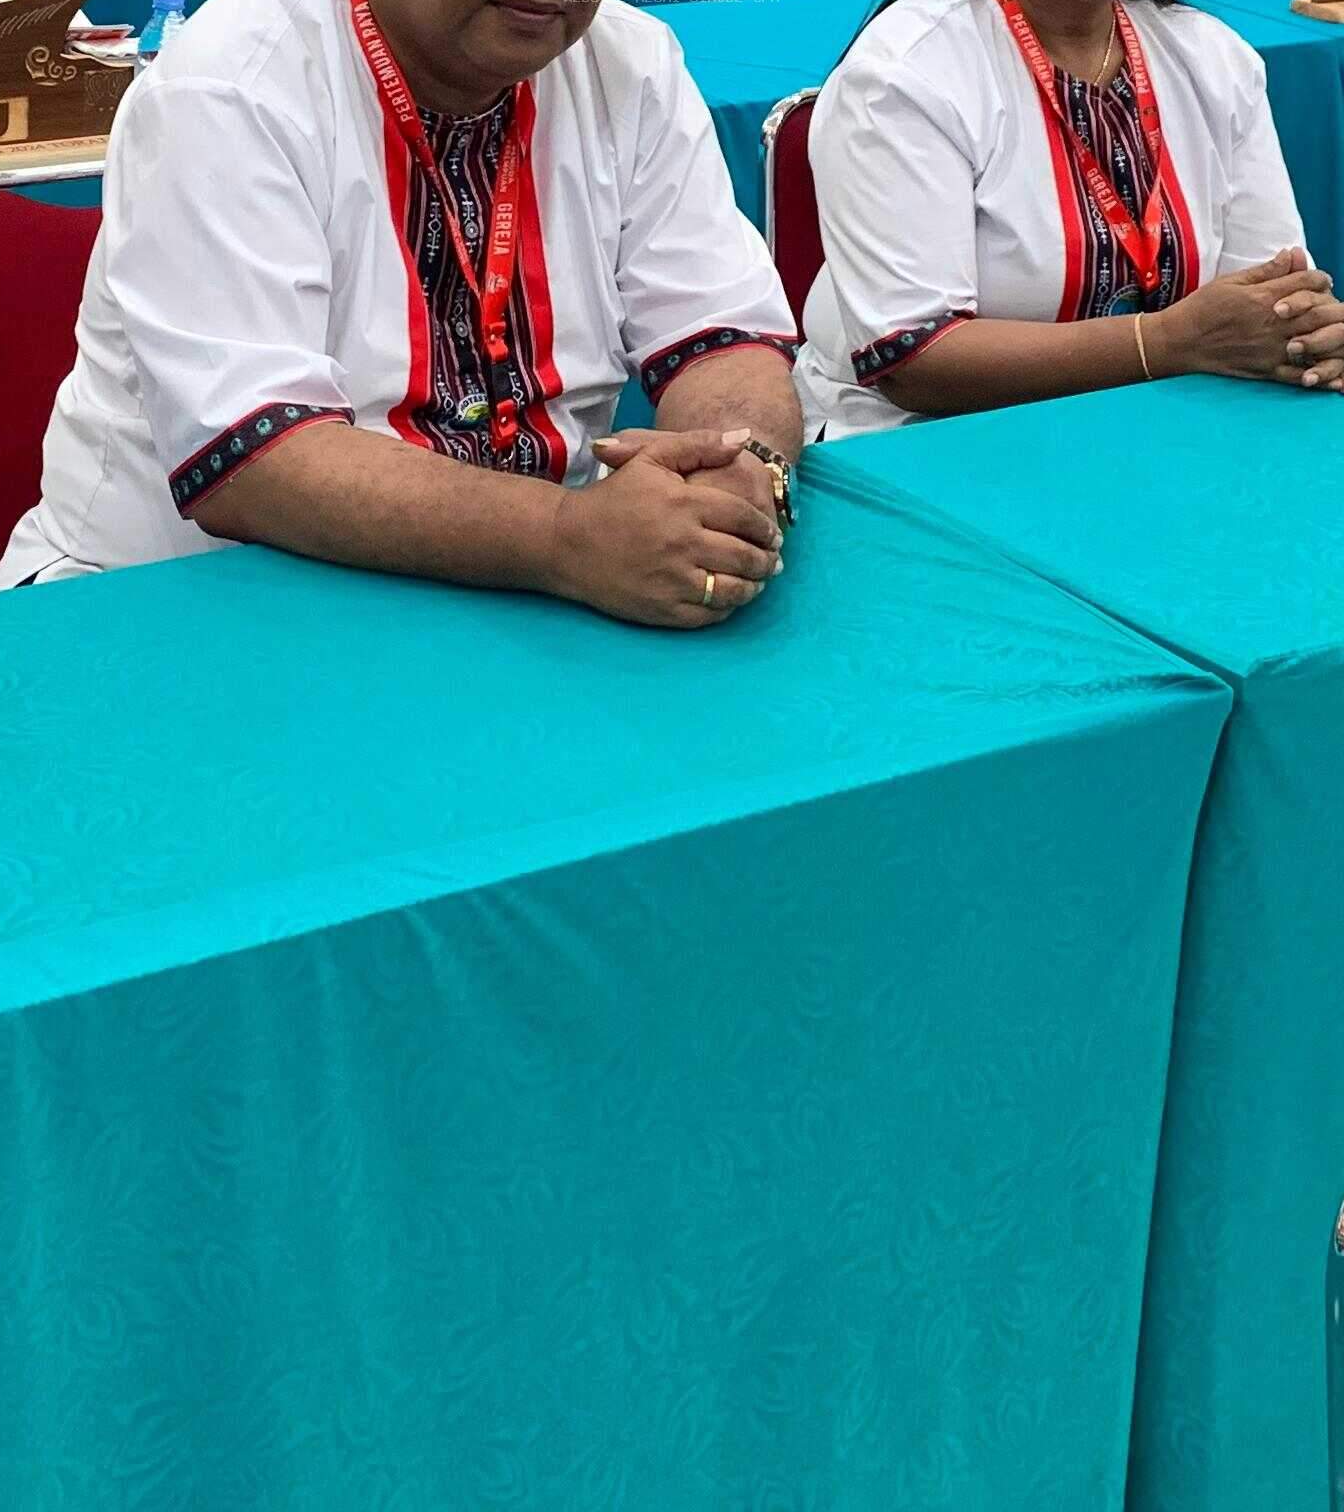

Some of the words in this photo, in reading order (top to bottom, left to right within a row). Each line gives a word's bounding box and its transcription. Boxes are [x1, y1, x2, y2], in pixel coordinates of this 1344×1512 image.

[354, 0, 376, 38] RAYA
[1010, 13, 1052, 88] PERTEMUAN
[365, 36, 414, 124] PERTEMUAN
[1086, 167, 1117, 215] GEREJA
[493, 202, 514, 256] GEREJA
